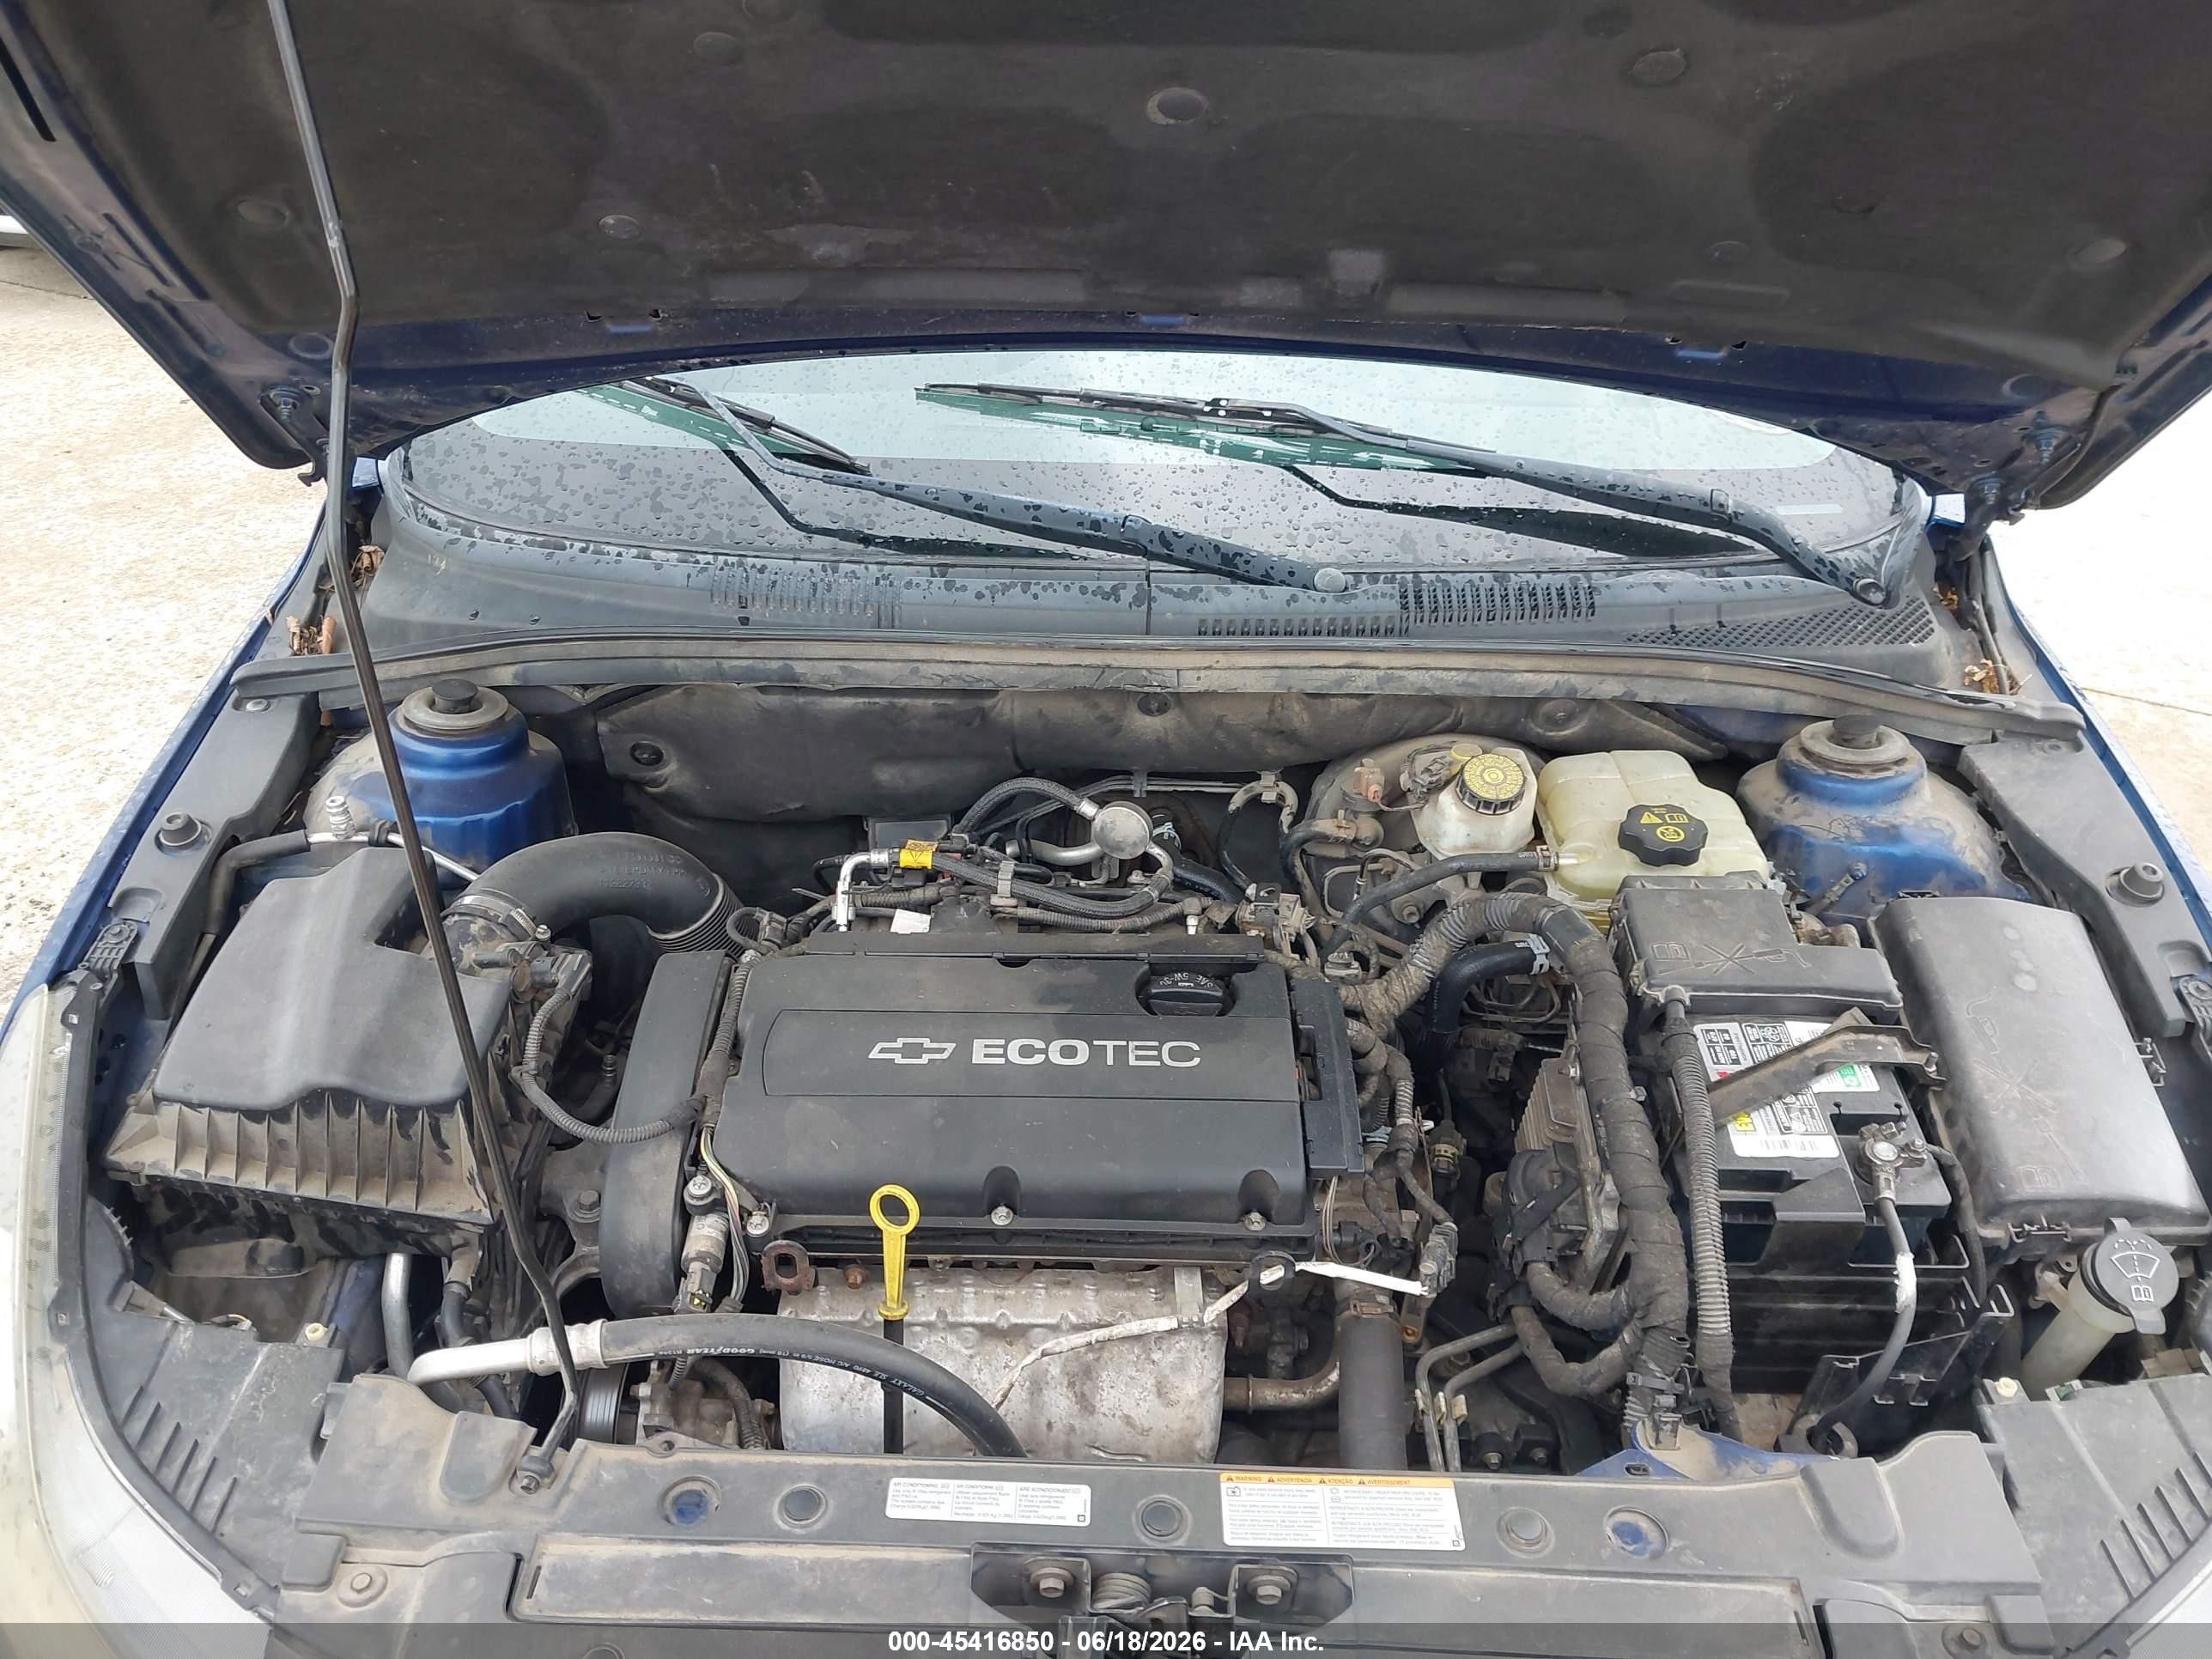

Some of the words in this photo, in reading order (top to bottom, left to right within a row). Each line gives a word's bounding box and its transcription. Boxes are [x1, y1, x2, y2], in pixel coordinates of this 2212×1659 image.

[971, 1038, 1201, 1067] ECOTEC
[686, 1346, 756, 1355] GOODYEAR
[813, 1355, 836, 1365] HOSE
[890, 1377, 925, 1396] GALAXY
